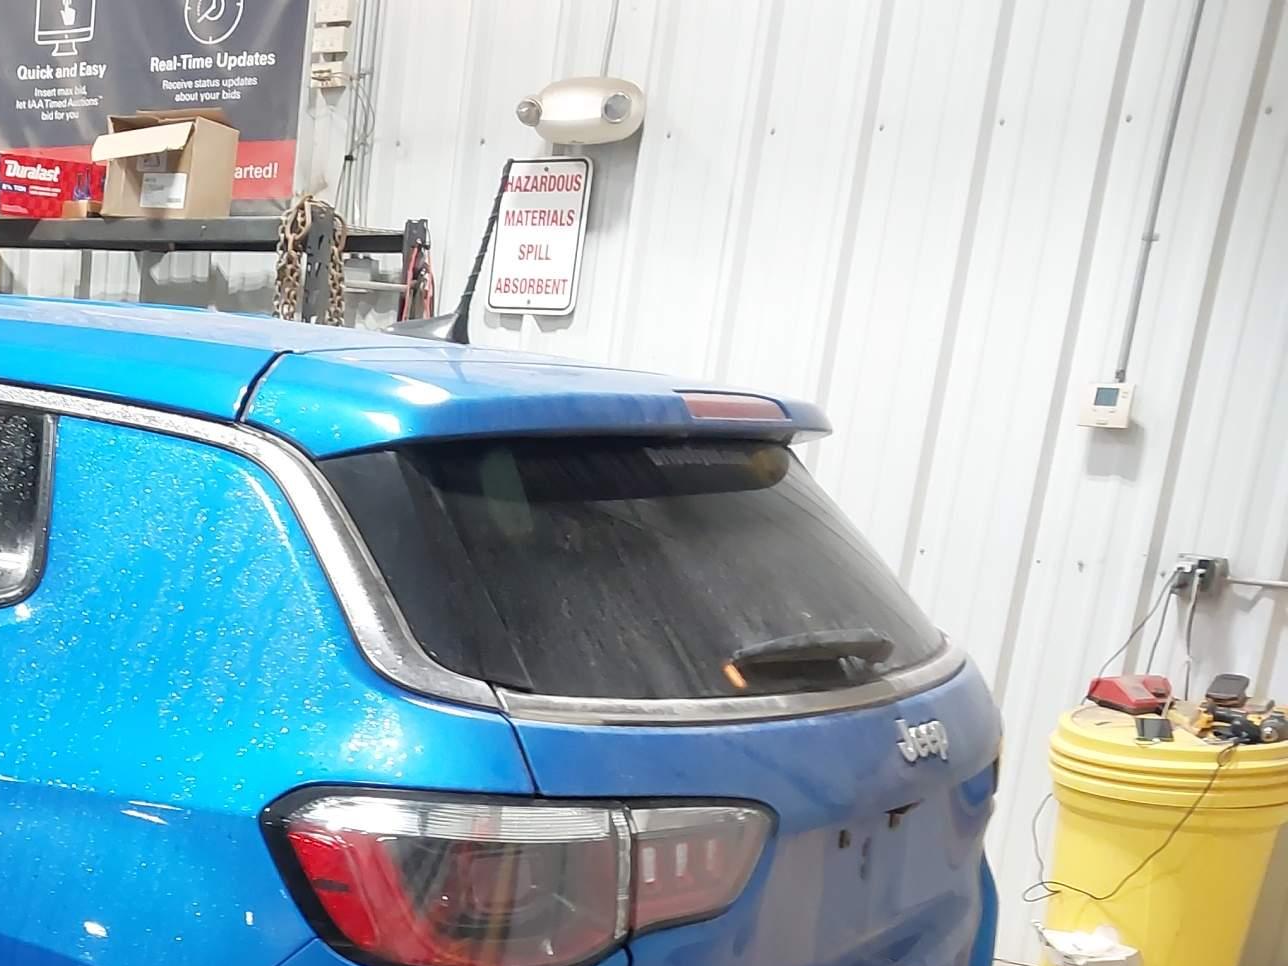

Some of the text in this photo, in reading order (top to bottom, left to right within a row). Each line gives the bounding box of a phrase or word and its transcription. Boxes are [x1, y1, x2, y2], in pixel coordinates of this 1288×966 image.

[150, 51, 276, 72] Real-Time Updates
[16, 62, 107, 80] Quick and Easy
[35, 88, 56, 97] Insert
[162, 77, 258, 90] Receive status updates
[16, 99, 26, 109] let
[44, 98, 67, 108] Timed
[174, 90, 241, 102] about your bids
[41, 110, 79, 120] bid for you
[4, 159, 61, 183] Duralast
[233, 162, 279, 180] arted!
[504, 174, 582, 193] HAZARDOUS
[504, 209, 576, 227] MATERIALS
[518, 244, 552, 261] SPILL
[494, 277, 569, 296] ABSORBENT
[895, 718, 949, 763] Jeep
